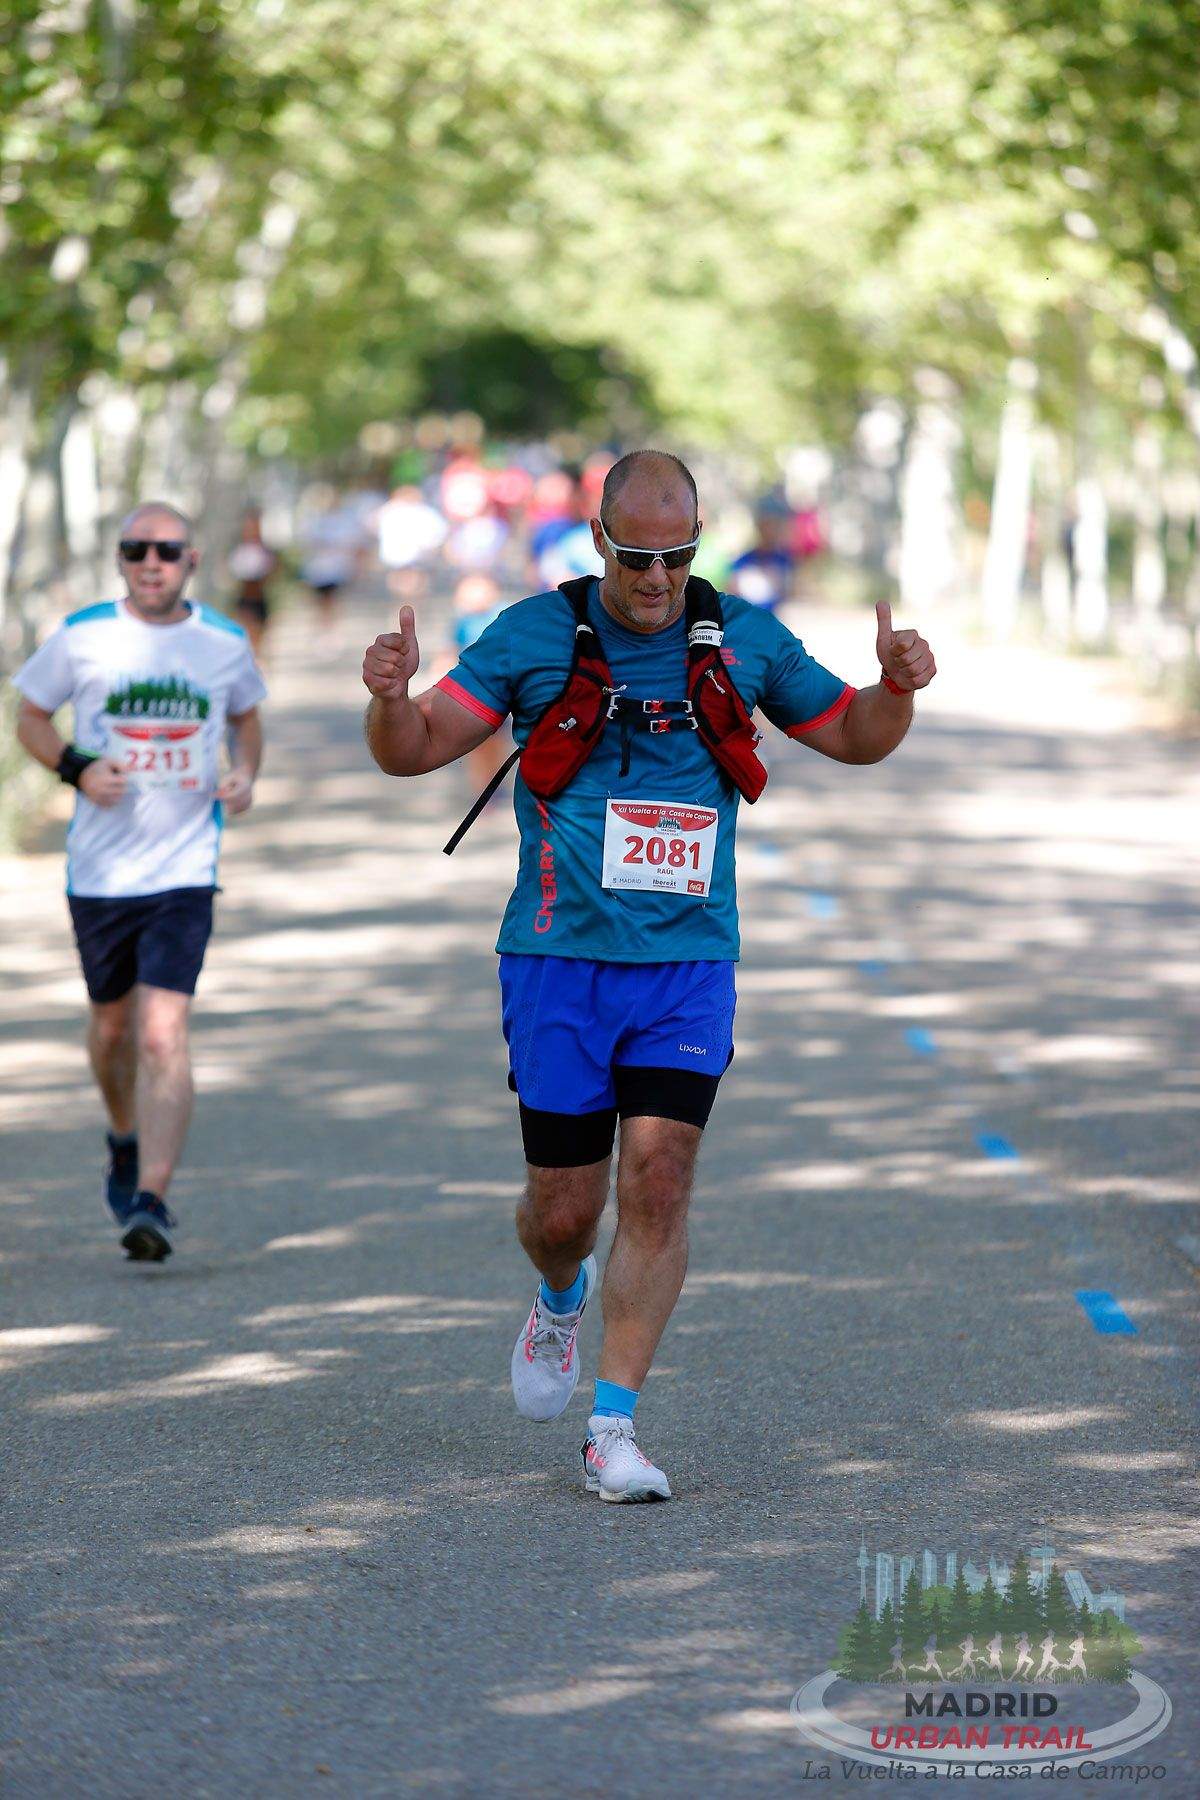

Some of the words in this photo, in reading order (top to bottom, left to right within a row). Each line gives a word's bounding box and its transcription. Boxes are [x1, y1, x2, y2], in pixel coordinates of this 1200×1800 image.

[126, 748, 190, 771] 2213
[628, 807, 651, 815] Vuelta
[659, 808, 666, 816] la
[668, 809, 684, 818] Casa
[685, 811, 694, 819] de
[693, 812, 715, 822] Campo
[622, 835, 701, 870] 2081
[656, 868, 675, 876] RAÚL
[534, 838, 558, 934] CHERRY
